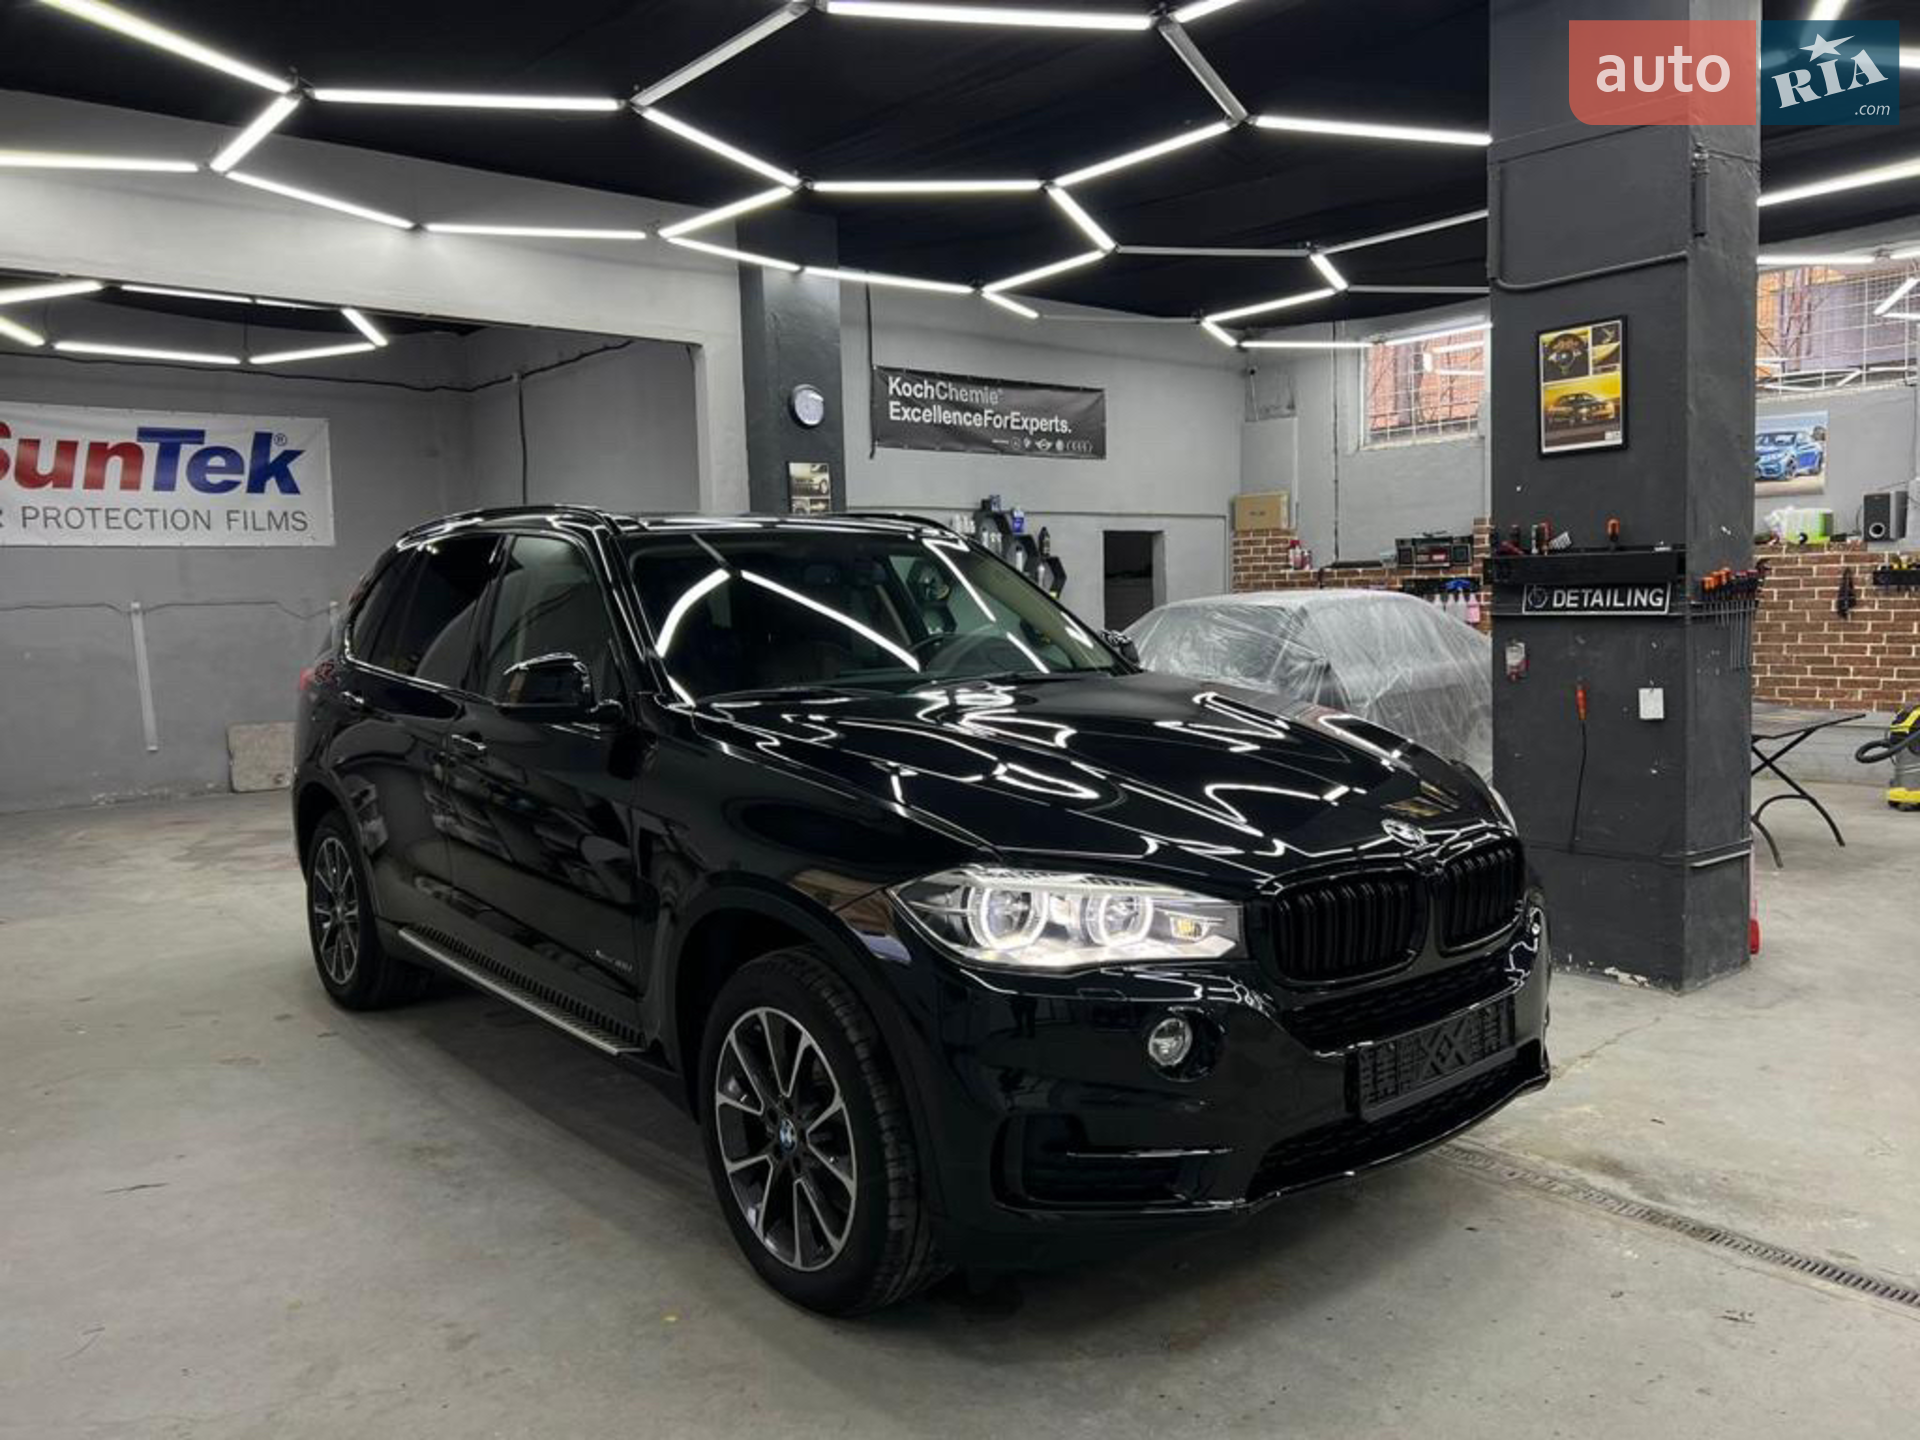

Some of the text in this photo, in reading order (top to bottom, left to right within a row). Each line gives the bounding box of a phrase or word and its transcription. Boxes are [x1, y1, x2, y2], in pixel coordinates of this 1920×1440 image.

[889, 402, 1072, 435] ExcellenceForExperts.
[21, 505, 211, 531] PROTECTION
[226, 510, 308, 532] FILMS
[1552, 588, 1664, 608] DETAILING
